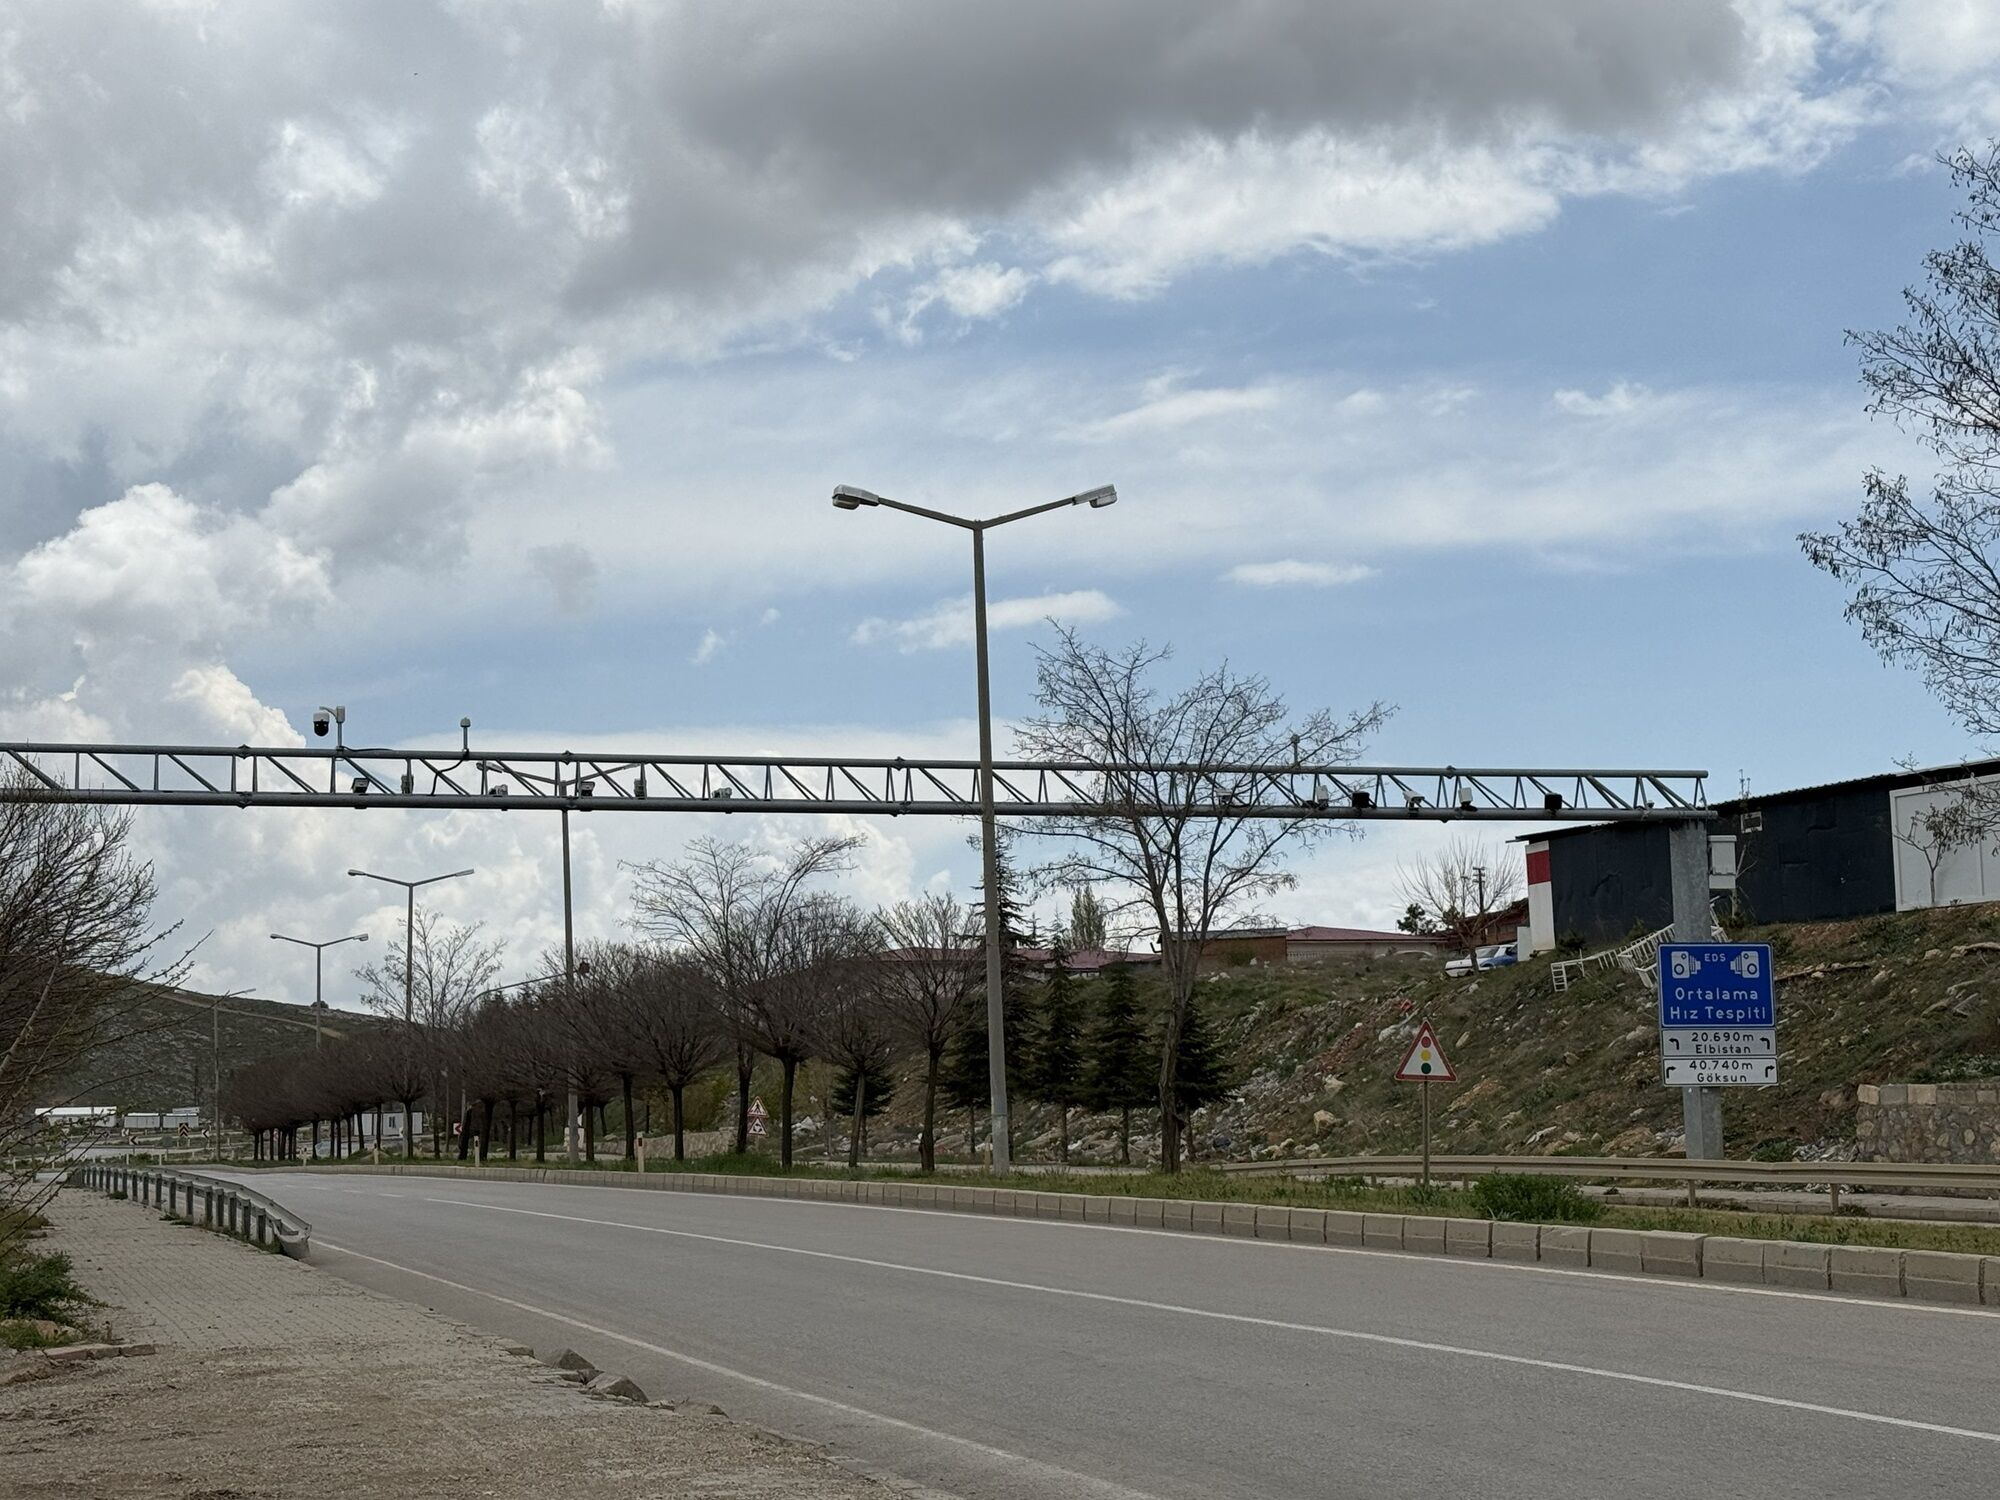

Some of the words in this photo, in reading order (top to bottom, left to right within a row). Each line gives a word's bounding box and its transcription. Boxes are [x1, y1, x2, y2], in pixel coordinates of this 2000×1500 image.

[1704, 953, 1726, 962] EDS
[1675, 987, 1759, 1001] Ortalama
[1670, 1006, 1699, 1020] Hız
[1705, 1006, 1766, 1022] Tespiti
[1691, 1032, 1754, 1043] 20.690m
[1695, 1044, 1751, 1054] Elbistan
[1689, 1060, 1753, 1071] 40.740m
[1697, 1072, 1747, 1082] Göksun
